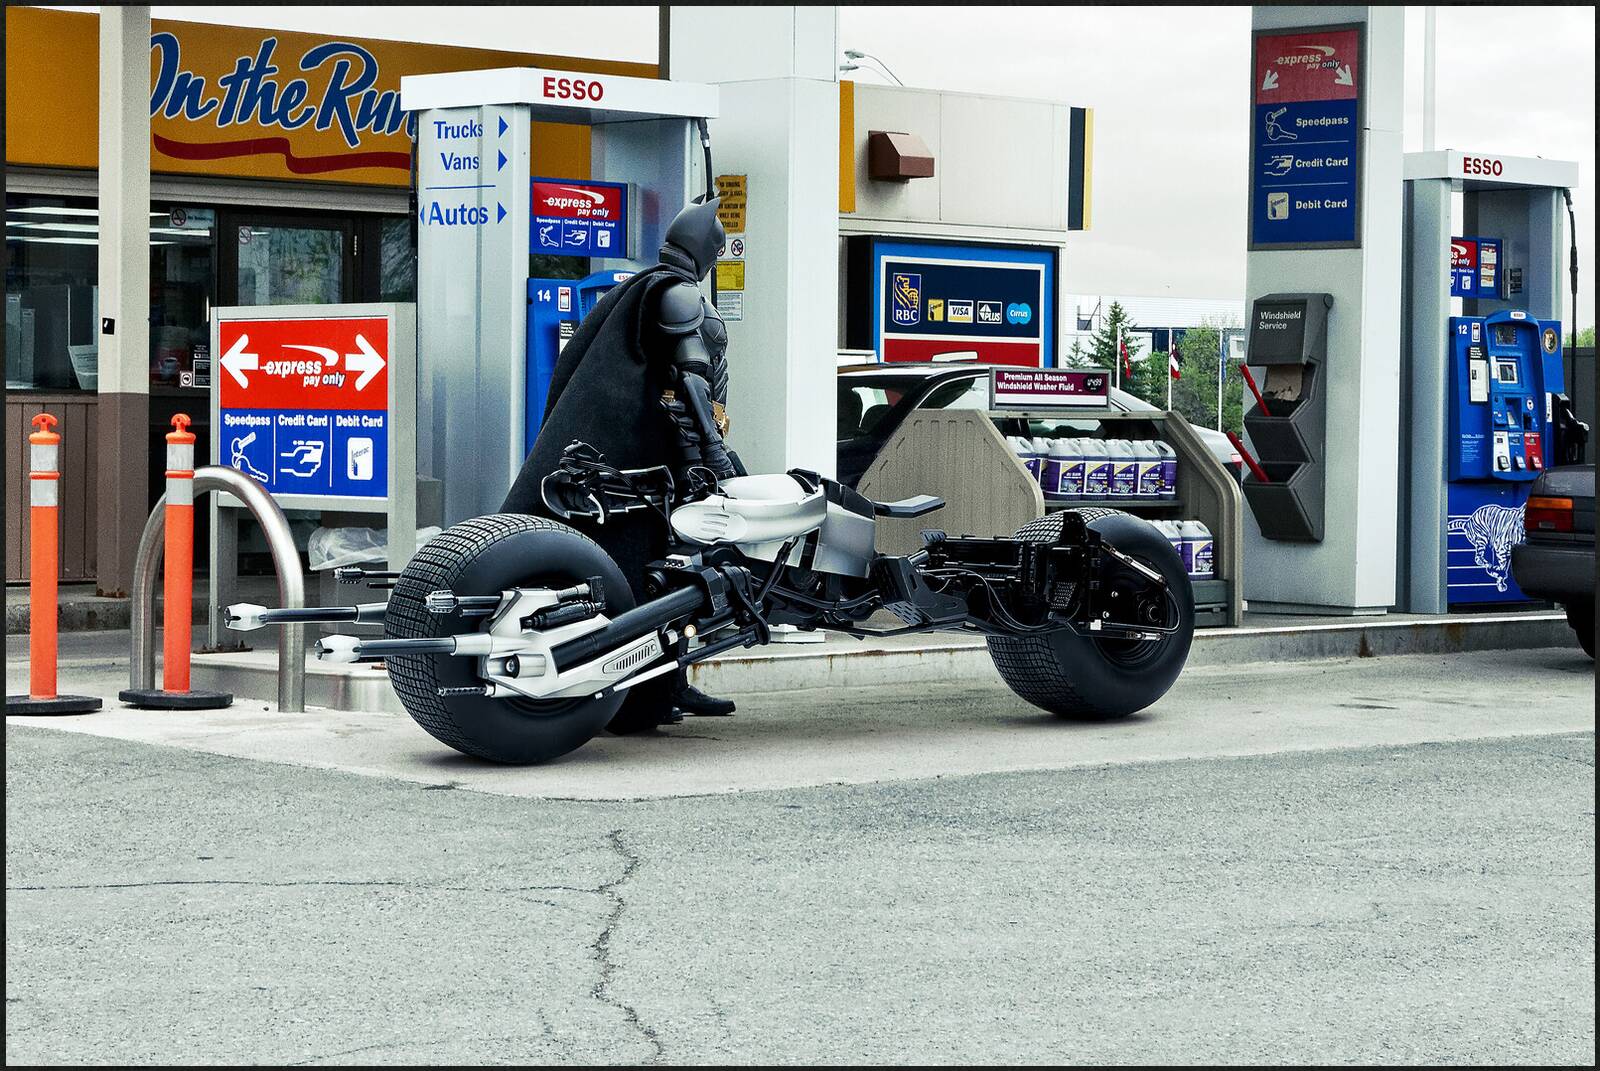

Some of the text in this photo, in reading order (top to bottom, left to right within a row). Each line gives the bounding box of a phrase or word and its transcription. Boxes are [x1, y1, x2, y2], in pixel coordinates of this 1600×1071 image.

[1278, 54, 1322, 66] express
[1322, 60, 1340, 69] only
[213, 36, 316, 129] the
[300, 42, 415, 148] Run
[543, 77, 604, 102] ESSO
[1296, 116, 1349, 128] Speedpass
[434, 119, 484, 140] Trucks
[441, 152, 480, 171] Vans
[1296, 157, 1348, 168] Credit Card
[1463, 157, 1503, 177] ESSO
[547, 196, 592, 208] express
[1296, 199, 1348, 209] Debit Card
[428, 202, 488, 226] Autos
[577, 208, 609, 218] pay only
[536, 290, 551, 302] 14
[895, 309, 918, 322] RBC
[952, 307, 969, 316] VISA
[984, 312, 1000, 322] PLUS
[1260, 311, 1301, 319] Windshield
[1259, 321, 1287, 329] Service
[1458, 324, 1468, 334] 12
[266, 360, 322, 378] express
[303, 372, 345, 388] pay only
[1004, 373, 1032, 382] Premium
[1044, 374, 1068, 382] Season
[997, 382, 1075, 392] Windshield Washer Fluid
[224, 414, 271, 428] Speedpass
[278, 414, 328, 427] Credit Card
[336, 415, 383, 427] Debit Card
